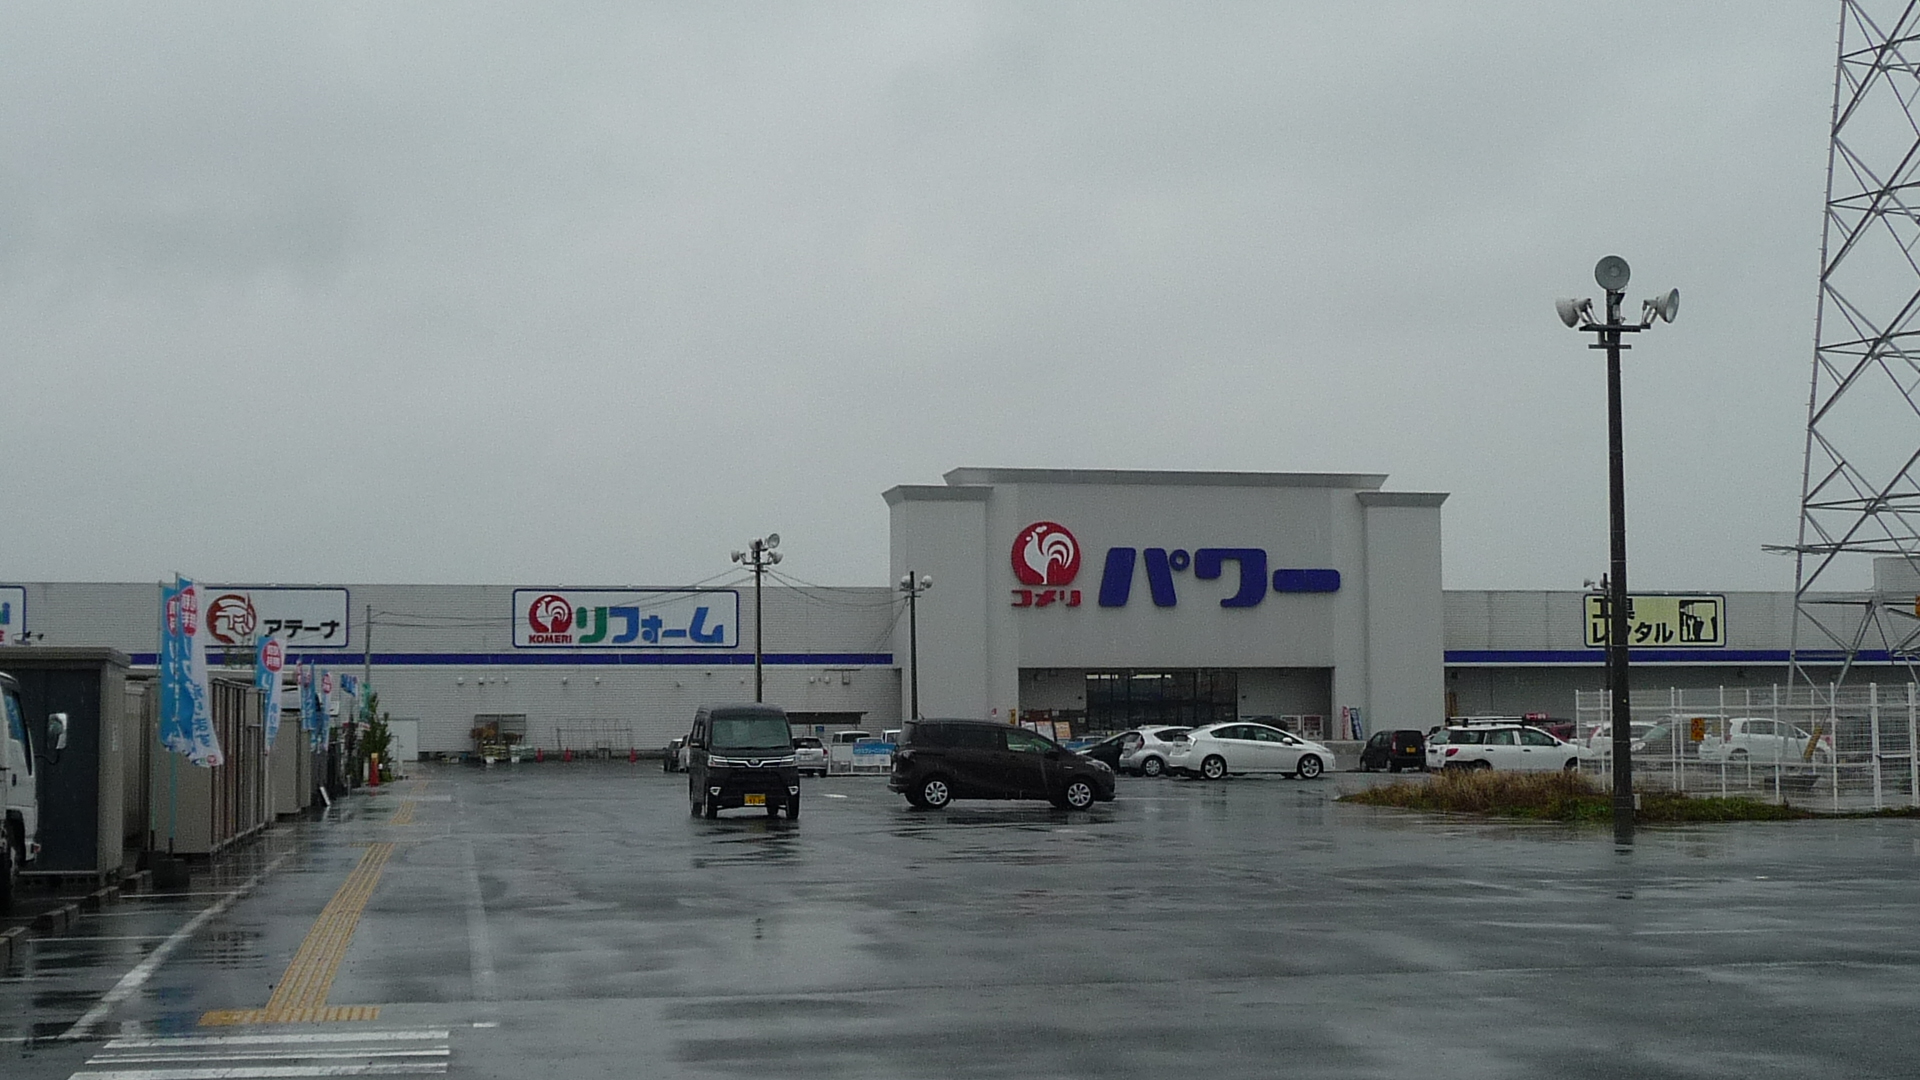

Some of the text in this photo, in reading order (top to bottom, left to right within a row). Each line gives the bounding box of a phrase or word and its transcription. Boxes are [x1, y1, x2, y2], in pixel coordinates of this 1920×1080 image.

[1098, 547, 1340, 608] パワー
[1011, 589, 1081, 607] コメリ
[263, 619, 340, 639] アテーナ
[575, 606, 723, 644] リフォーム
[1592, 622, 1674, 643] レタル
[528, 634, 572, 644] KOMERI
